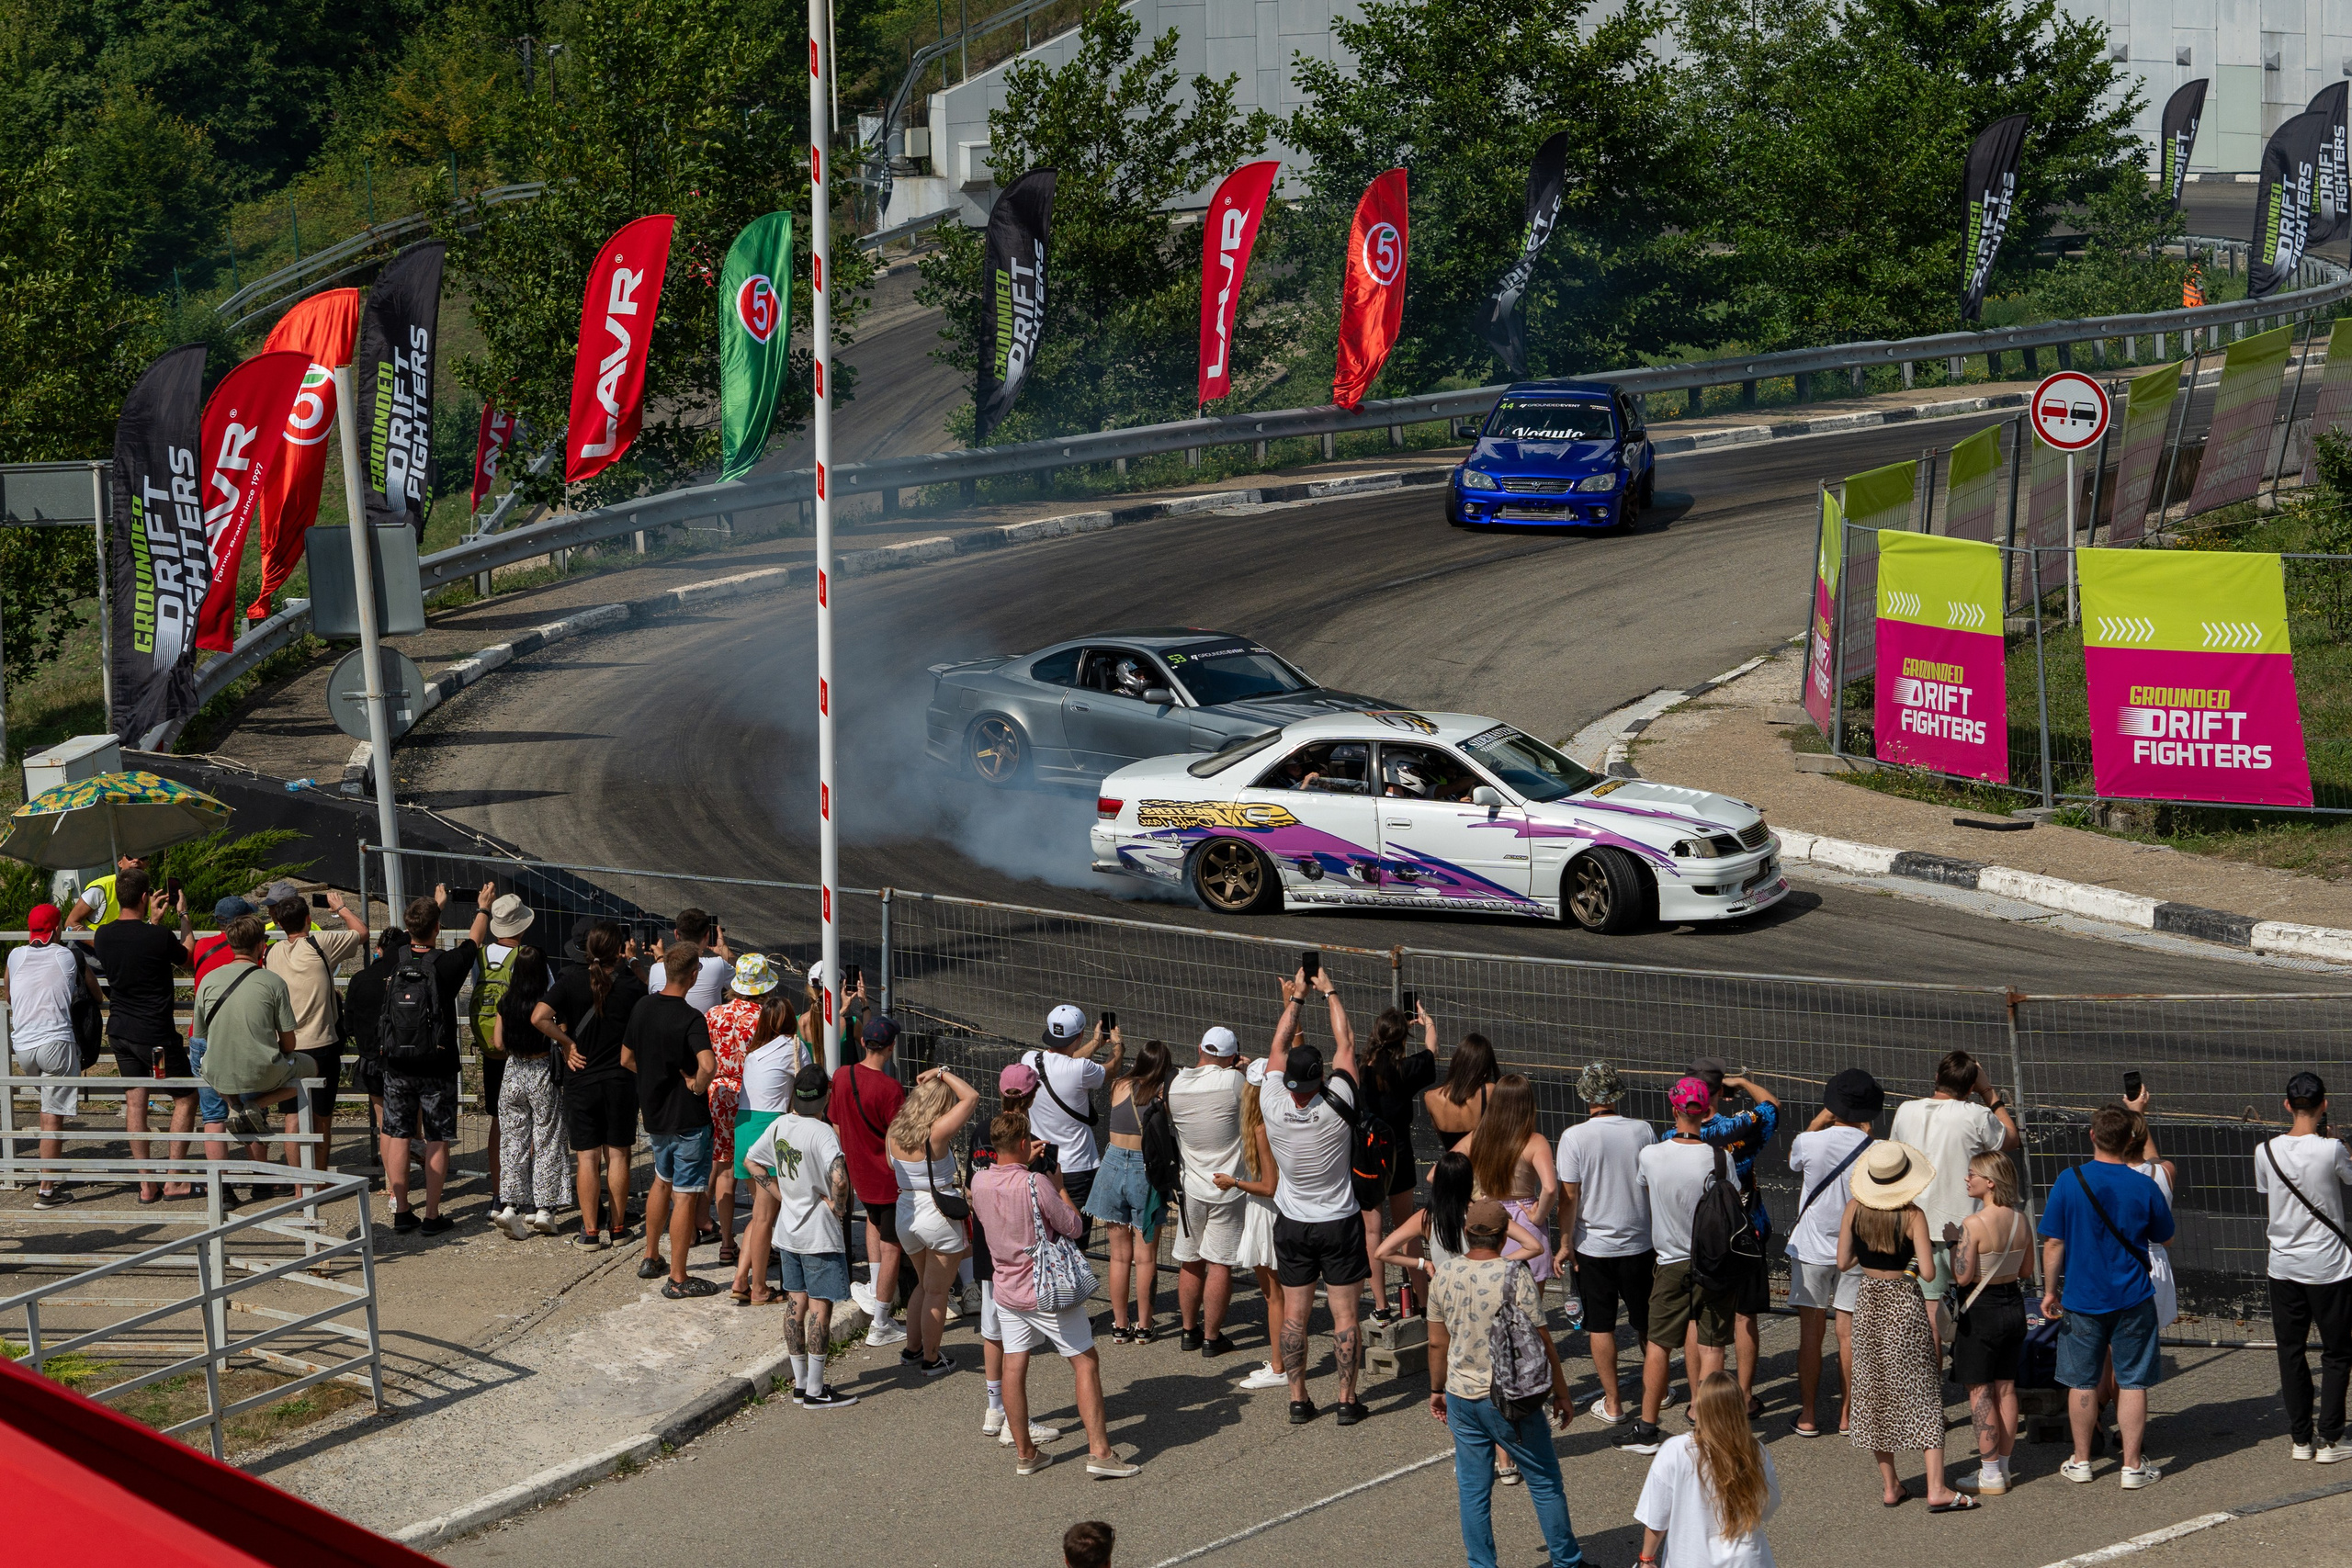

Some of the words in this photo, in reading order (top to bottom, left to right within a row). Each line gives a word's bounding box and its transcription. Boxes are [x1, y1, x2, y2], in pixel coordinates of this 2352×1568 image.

[2261, 182, 2283, 266] GROUNDED
[2276, 174, 2298, 255] DRIFT
[2290, 161, 2312, 269] FIGHTERS
[2333, 125, 2348, 213] FIGHTERS
[993, 268, 1013, 382] GROUNDED
[1007, 256, 1035, 373] DRIFT
[1206, 208, 1250, 379] LAVR
[386, 345, 414, 480] DRIFT
[406, 324, 428, 502] FIGHTERS
[580, 267, 644, 458] LAVR
[370, 361, 394, 494] GROUNDED
[207, 419, 258, 570] AVR
[213, 549, 232, 583] Family
[230, 516, 246, 548] Brand
[241, 489, 256, 515] since
[250, 462, 264, 487] 1997
[130, 494, 155, 654] GROUNDED
[143, 474, 184, 637] DRIFT
[1167, 653, 1188, 664] 53
[1901, 678, 1973, 716] DRIFT
[1902, 657, 1964, 684] GROUNDED
[2130, 685, 2231, 710] GROUNDED
[1901, 708, 1986, 745] FIGHTERS
[2133, 739, 2272, 770] FIGHTERS
[2135, 708, 2247, 741] DRIFT
